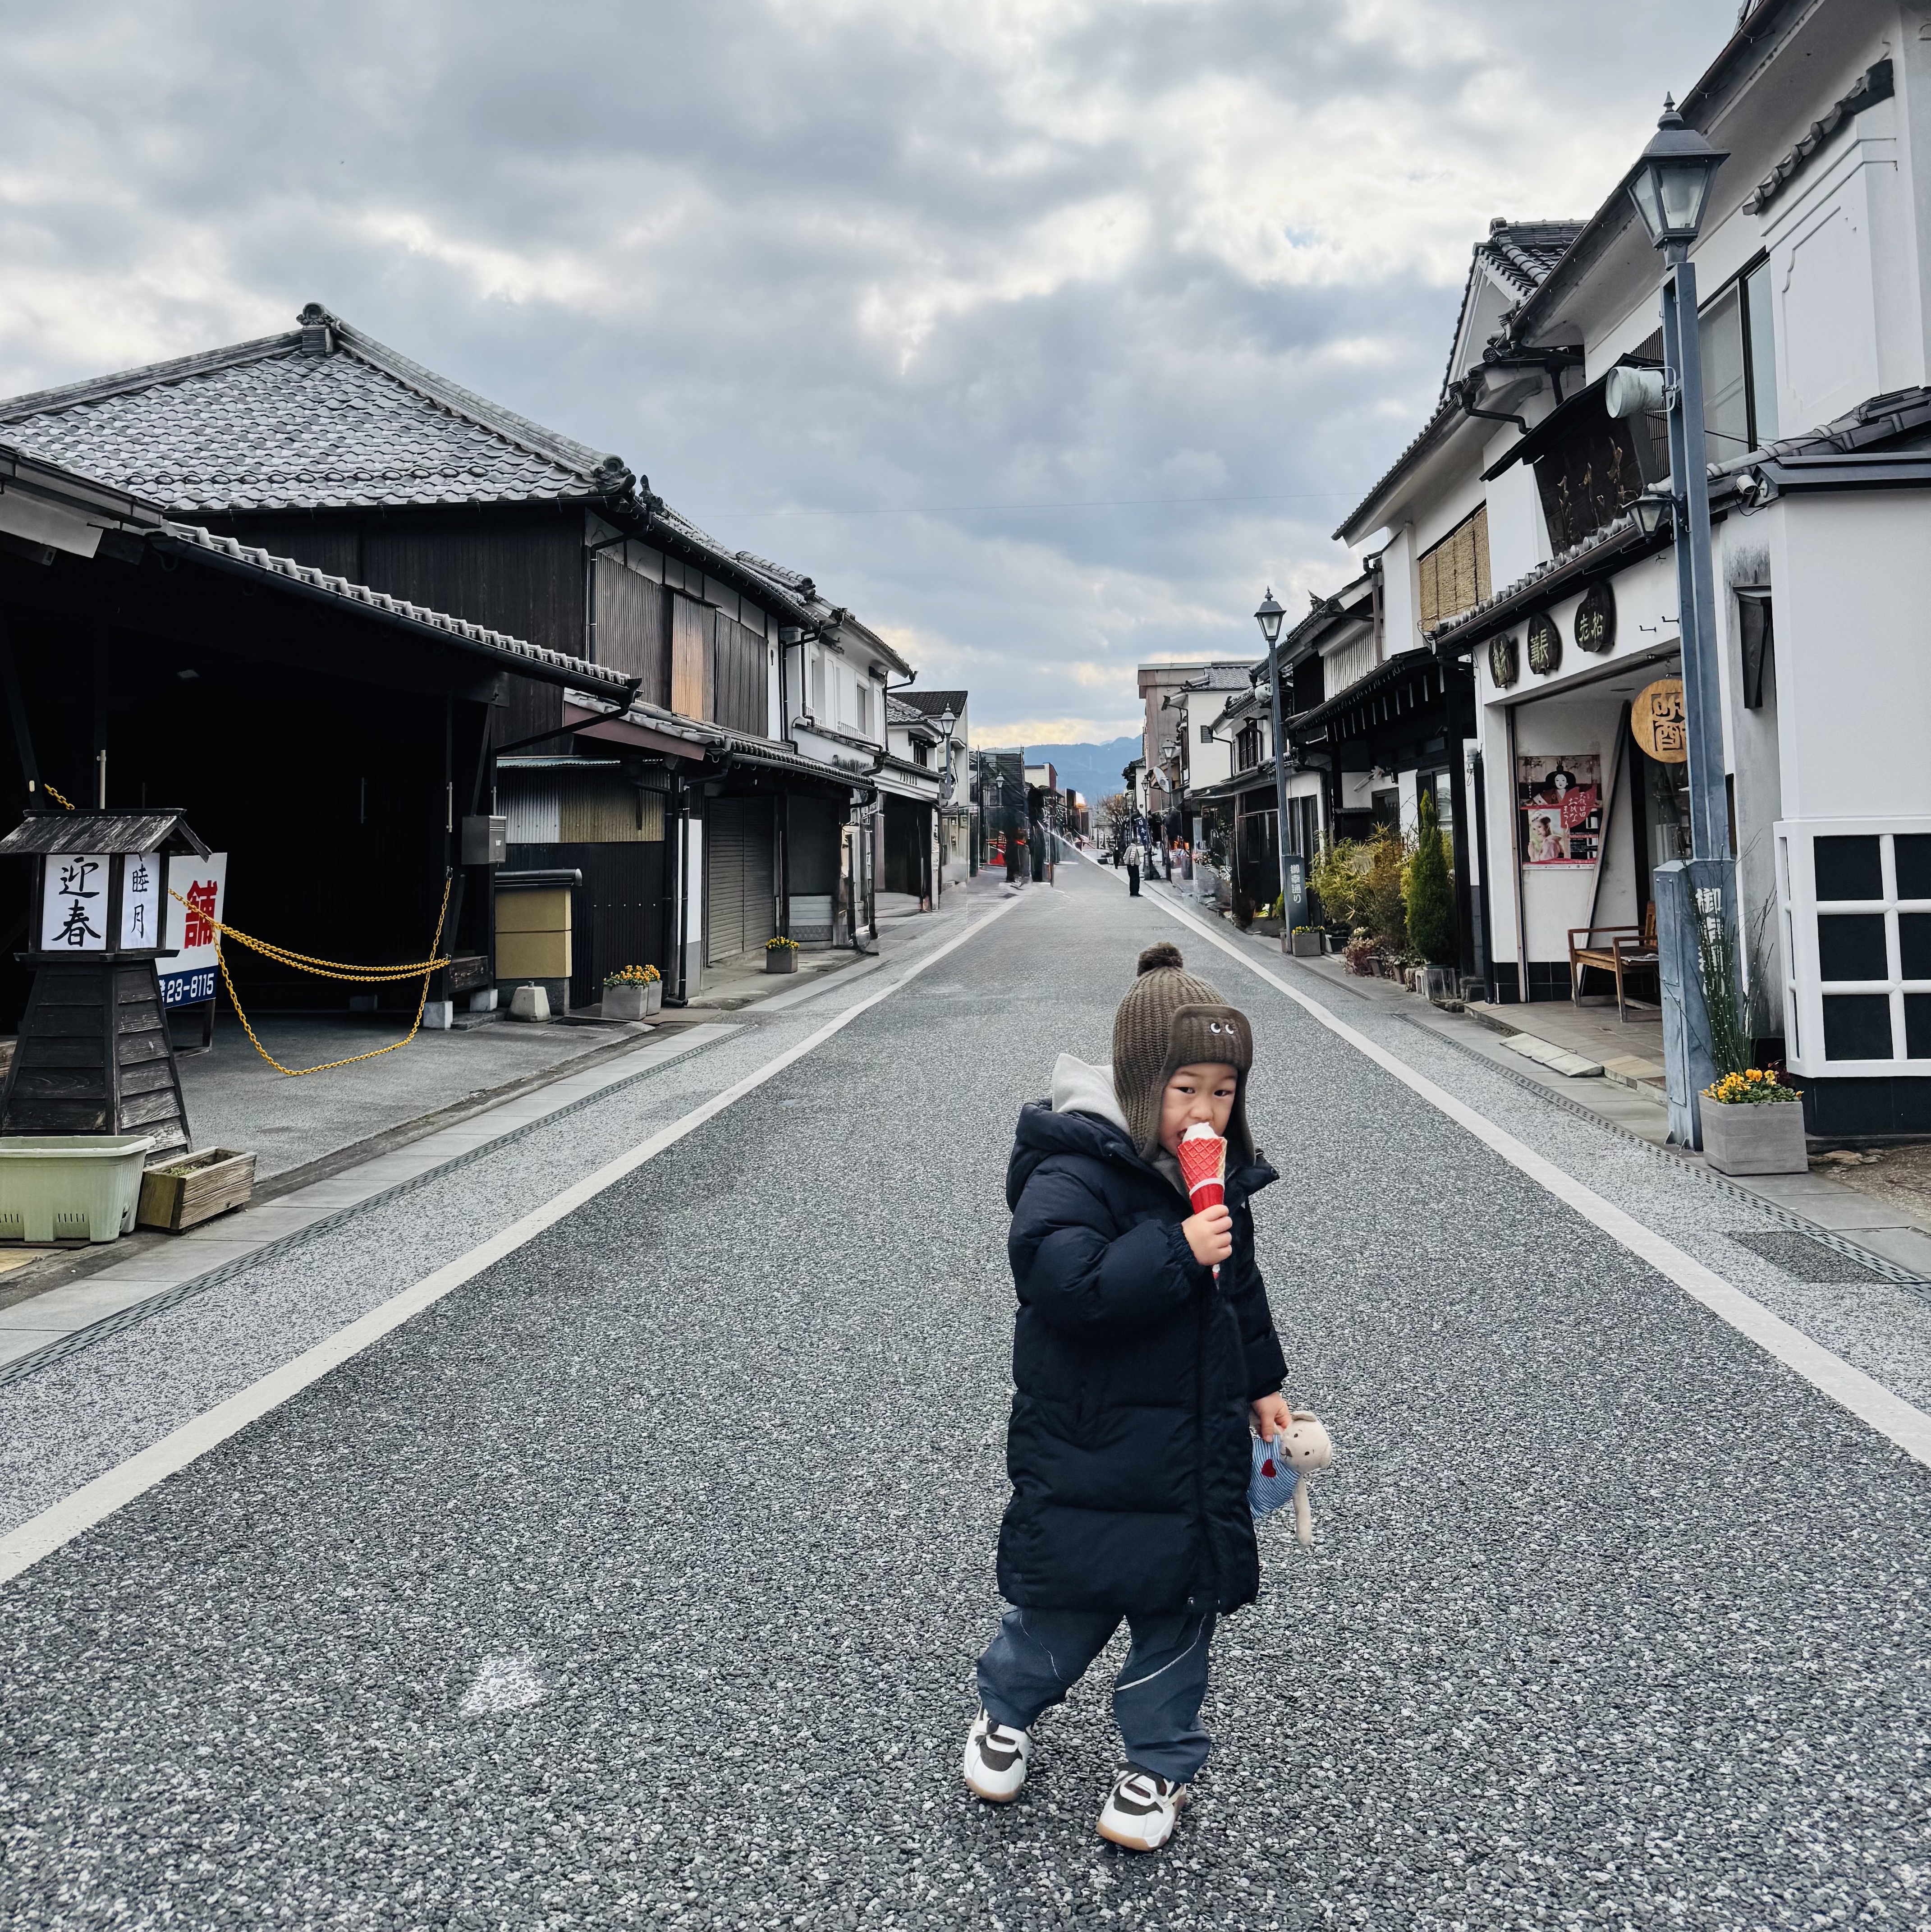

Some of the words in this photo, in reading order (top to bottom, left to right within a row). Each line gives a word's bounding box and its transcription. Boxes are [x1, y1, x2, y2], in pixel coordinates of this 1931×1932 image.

[51, 857, 101, 947] 迎春
[131, 863, 149, 939] 睦月
[166, 973, 214, 1003] 23-8115
